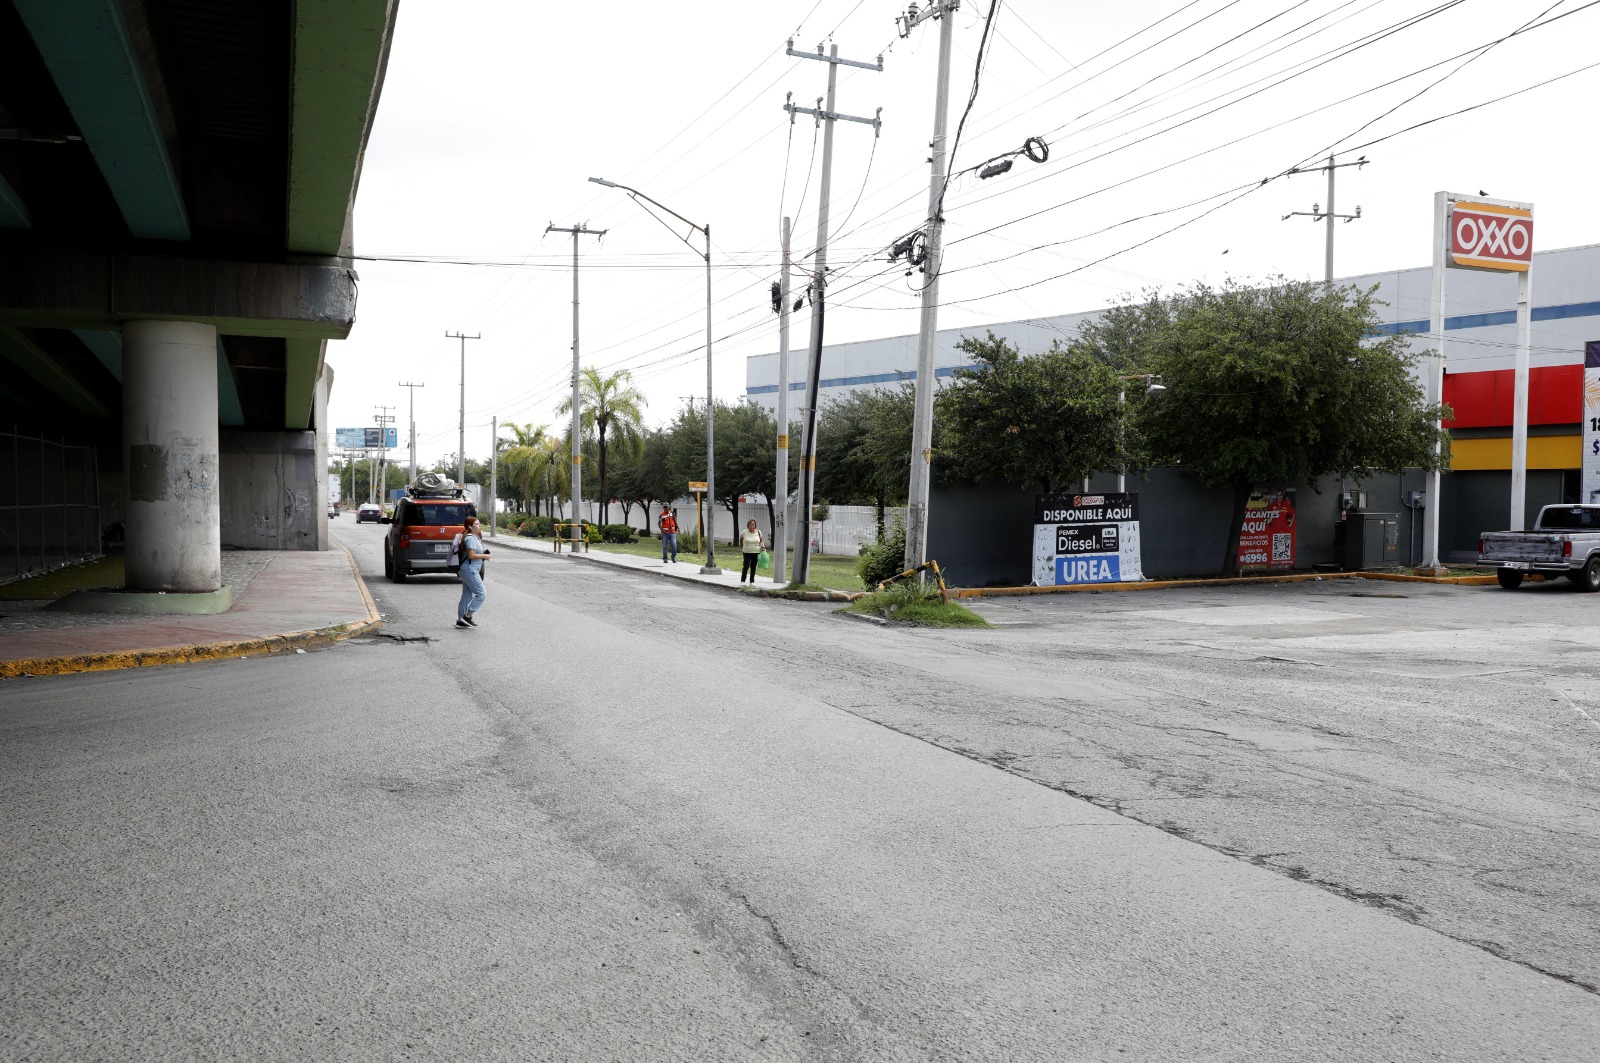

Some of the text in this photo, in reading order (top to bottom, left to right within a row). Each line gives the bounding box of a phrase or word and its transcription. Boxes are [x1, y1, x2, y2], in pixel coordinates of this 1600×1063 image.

[1456, 217, 1529, 256] OXXO
[1043, 504, 1132, 522] DISPONIBLE AQUÍ
[1245, 510, 1280, 519] ACANTES
[1241, 518, 1267, 534] AQUÍ
[1058, 535, 1096, 551] Diesel
[1063, 559, 1112, 583] UREA
